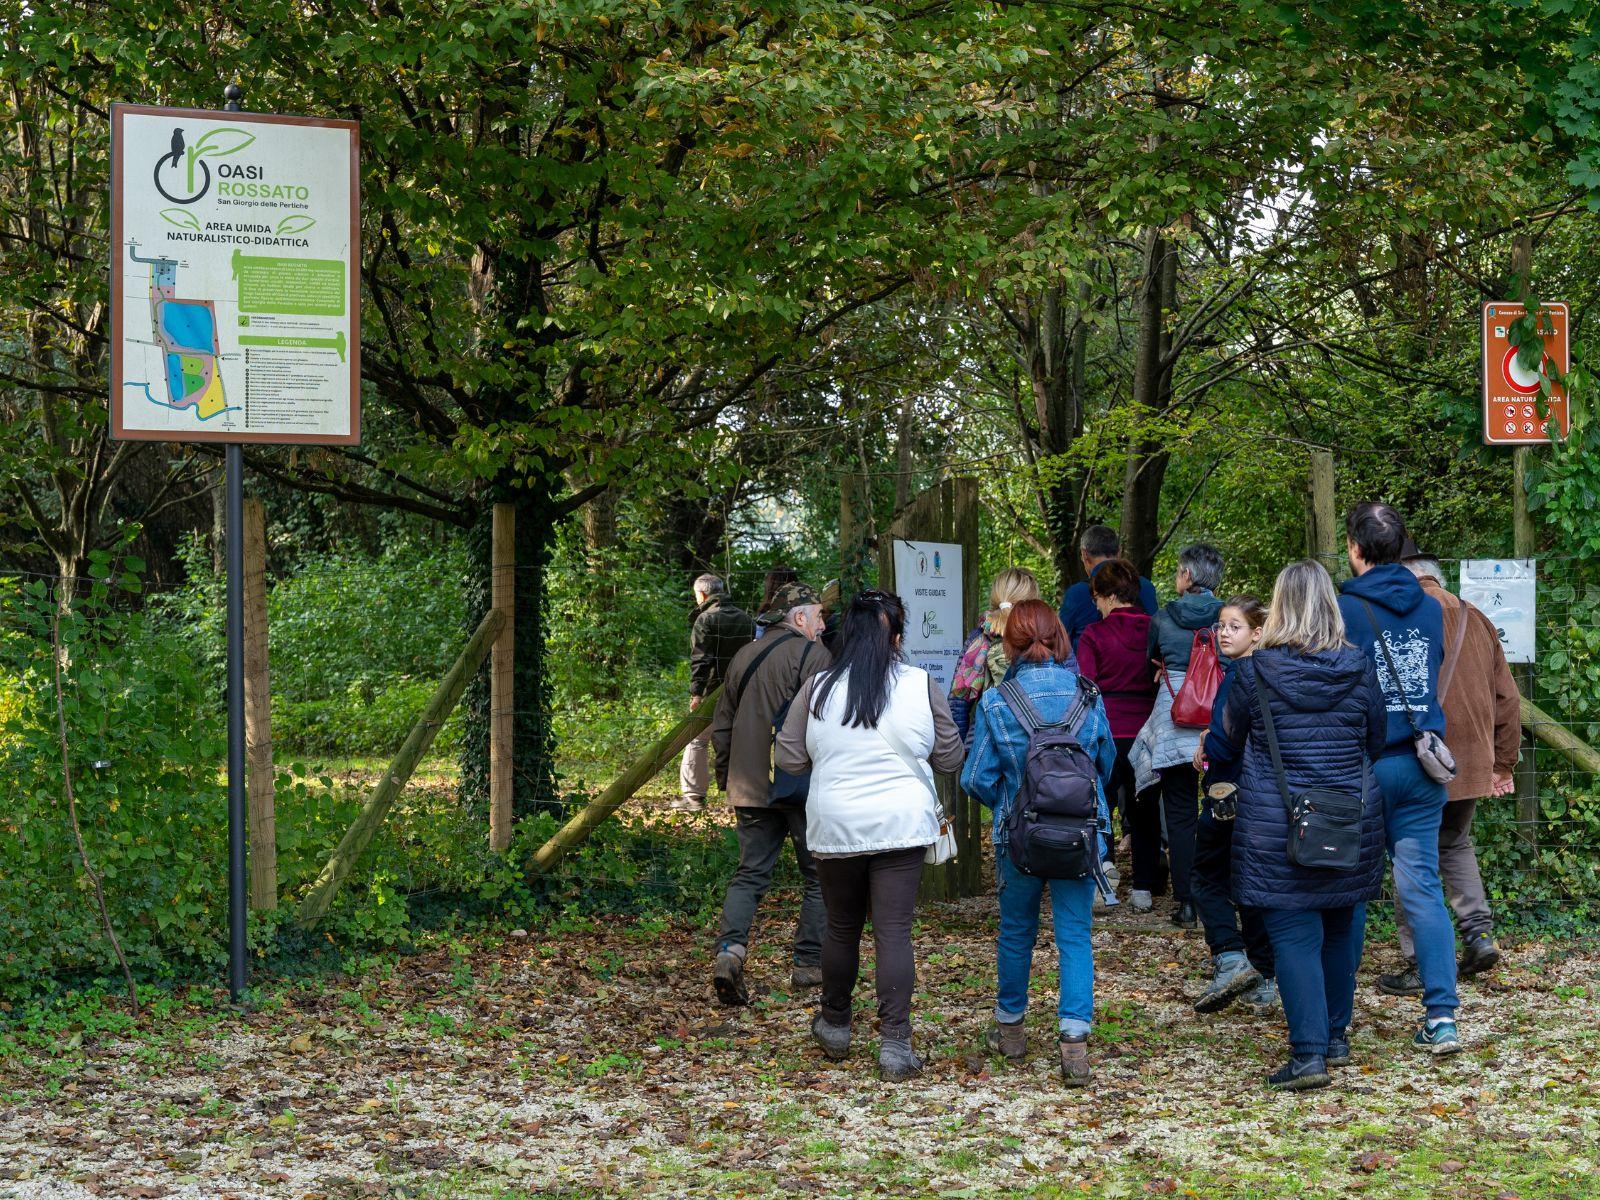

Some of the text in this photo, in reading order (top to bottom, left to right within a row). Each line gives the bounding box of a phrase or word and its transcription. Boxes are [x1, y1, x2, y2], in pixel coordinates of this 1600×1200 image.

[218, 164, 262, 180] OASI
[218, 182, 309, 200] ROSSATO
[206, 222, 272, 233] AREA UMIDA
[167, 232, 309, 247] NATURALISTICO-DIDATTICA
